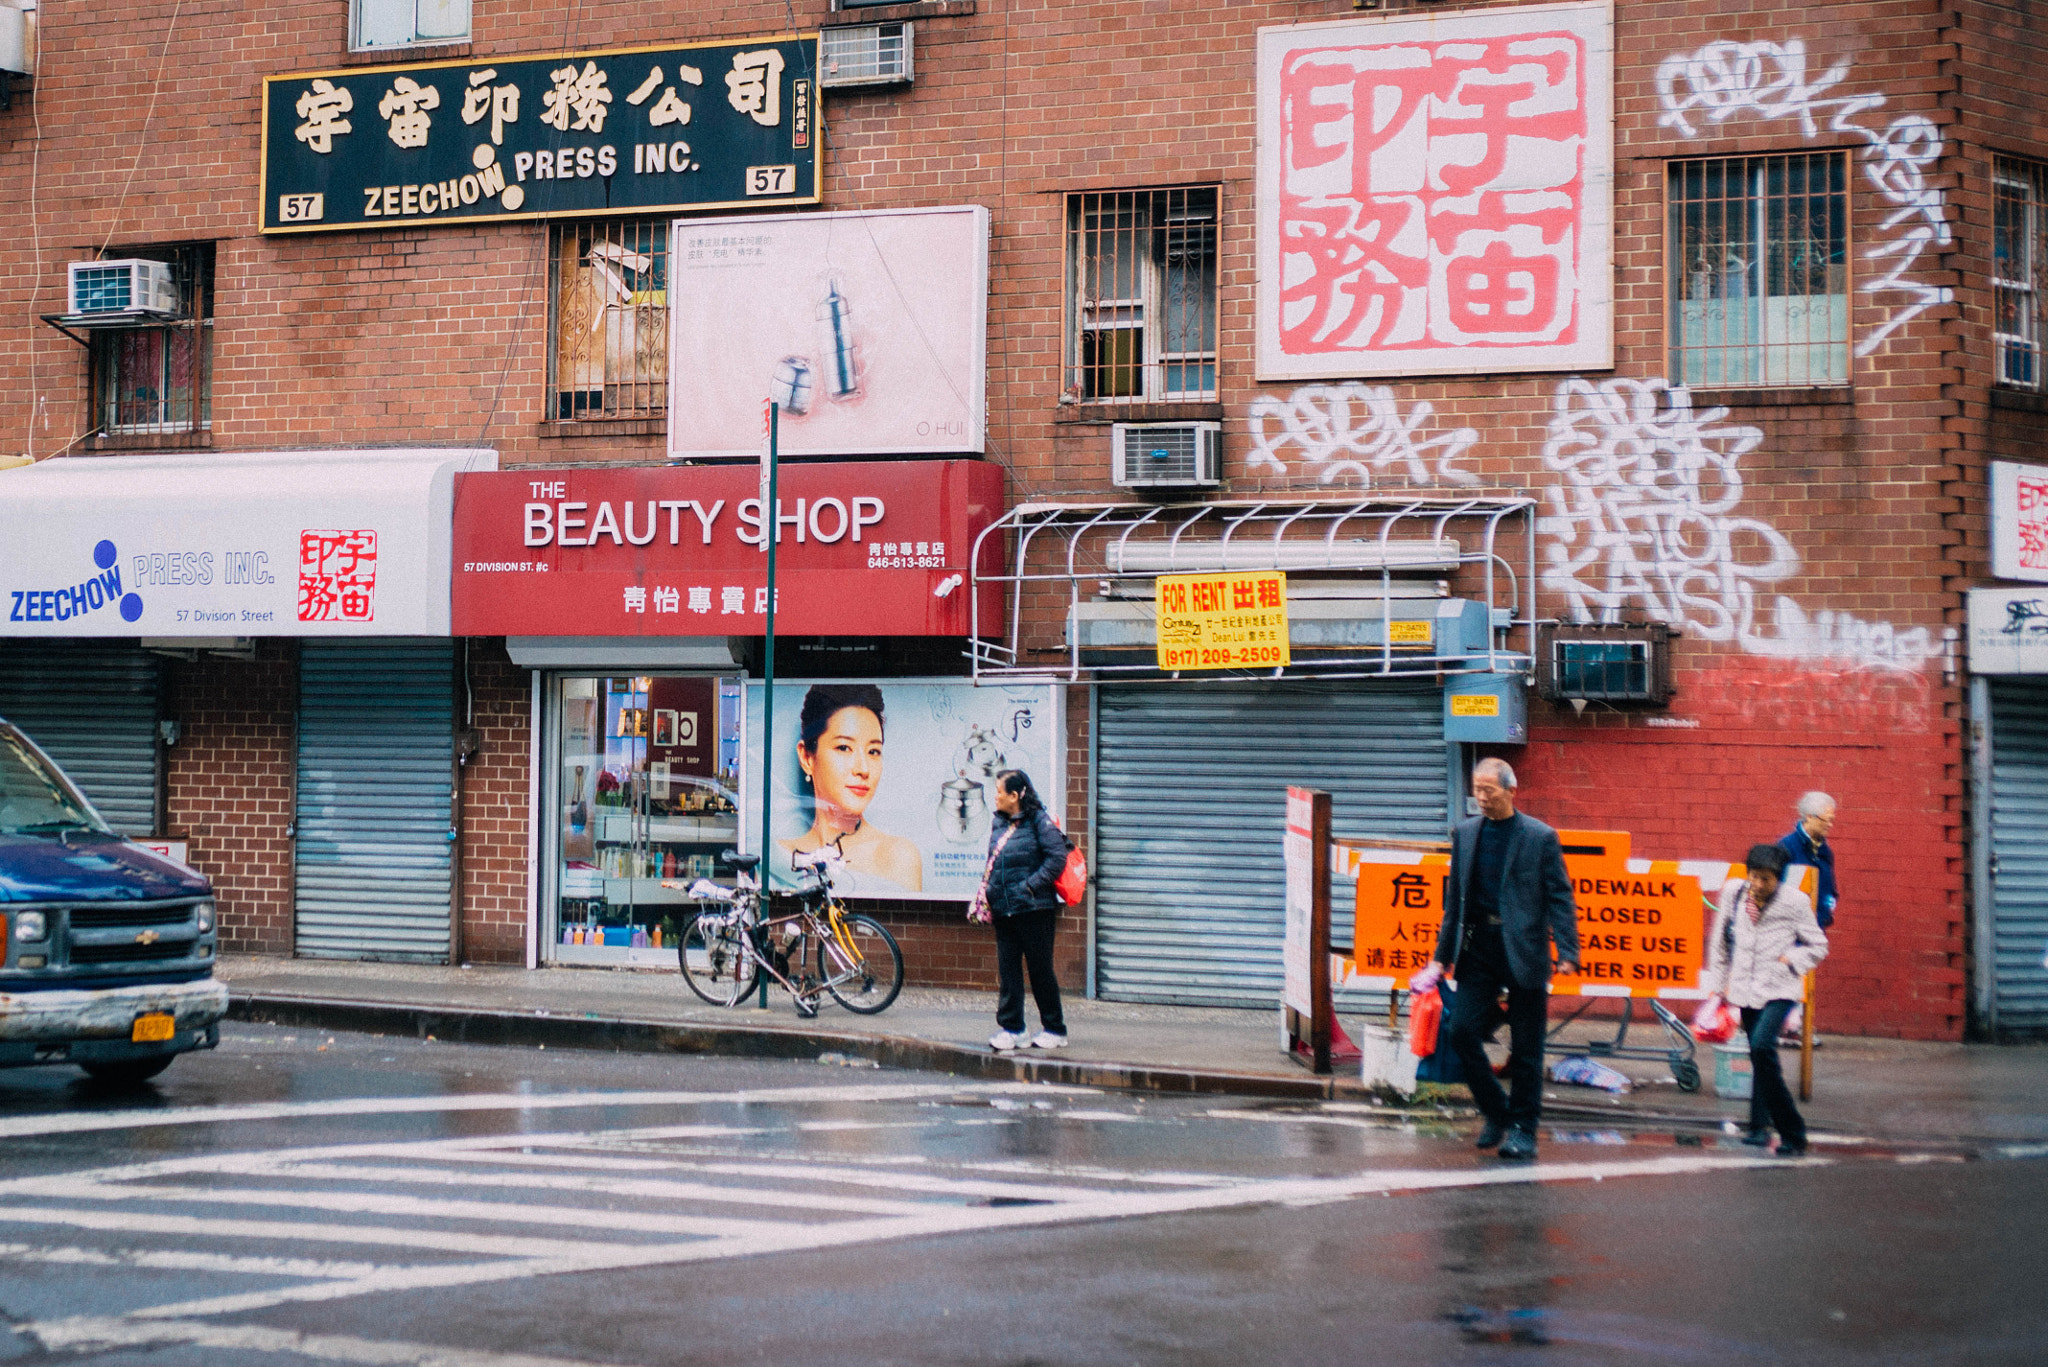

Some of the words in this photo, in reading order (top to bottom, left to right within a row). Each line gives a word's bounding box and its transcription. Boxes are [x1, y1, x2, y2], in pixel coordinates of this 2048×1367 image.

[295, 49, 785, 153] 宇宙印務公司
[514, 146, 617, 182] PRESS
[634, 142, 700, 174] INC.
[364, 161, 506, 217] ZEECHOW
[754, 168, 786, 191] 57
[287, 197, 315, 218] 57
[529, 481, 566, 499] THE
[524, 500, 725, 546] BEAUTY
[736, 497, 886, 545] SHOP
[133, 552, 214, 588] PRESS
[225, 551, 275, 585] INC.
[464, 562, 475, 572] 57
[476, 562, 518, 572] DIVISION
[519, 562, 534, 572] ST.
[868, 556, 946, 569] 646-613-8621
[10, 564, 124, 622] ZEECHOW
[1163, 583, 1187, 613] FOR
[1191, 581, 1227, 612] RENT
[1233, 579, 1281, 610] 出租
[176, 610, 189, 621] 57
[195, 609, 236, 621] Division
[241, 609, 274, 621] Street
[1212, 632, 1231, 643] Dean
[1165, 648, 1198, 667] (917)
[1201, 646, 1281, 664] 209-2509
[1571, 878, 1677, 898] IDEWALK
[1579, 933, 1632, 952] EASE
[1641, 936, 1688, 954] USE
[1632, 964, 1686, 981] SIDE
